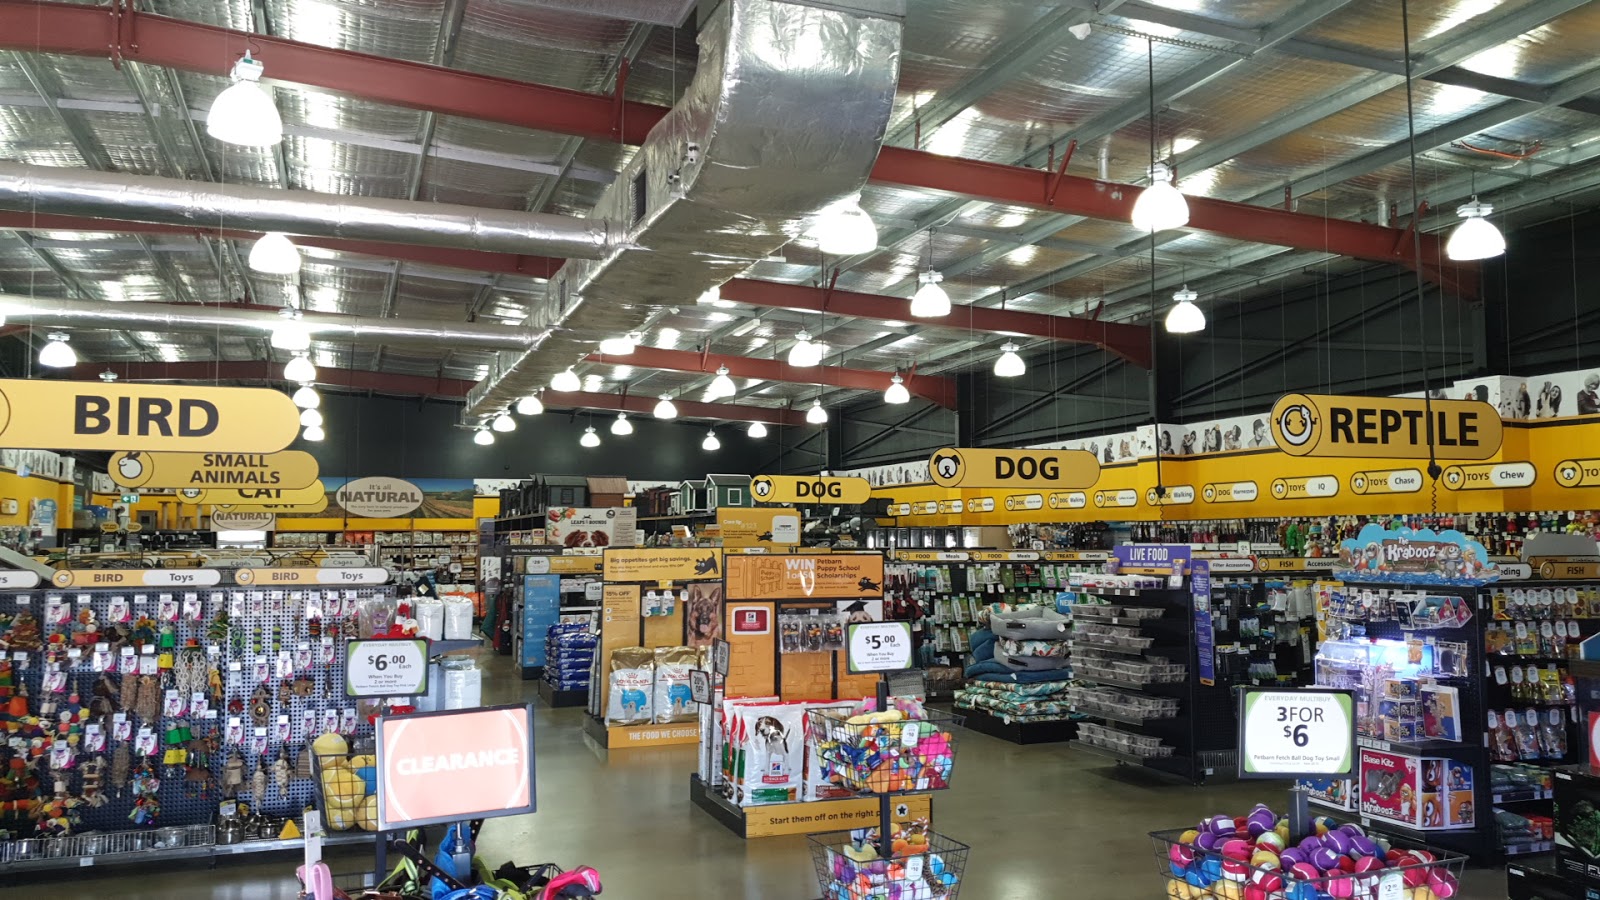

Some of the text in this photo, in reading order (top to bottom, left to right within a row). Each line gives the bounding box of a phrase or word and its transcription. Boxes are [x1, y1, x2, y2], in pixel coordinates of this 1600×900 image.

[74, 395, 219, 437] BIRD
[1330, 407, 1480, 447] REPTILE
[203, 453, 269, 468] SMALL
[995, 456, 1060, 480] DOG
[190, 470, 281, 485] ANIMALS
[1394, 477, 1415, 485] Chase
[1466, 471, 1525, 481] TOYS Chew
[238, 488, 281, 499] CAT
[796, 481, 842, 498] DOG
[1289, 483, 1326, 492] TOYS IQ
[340, 491, 420, 503] NATURAL
[216, 513, 270, 521] NATURAL
[1398, 536, 1409, 545] The
[1129, 548, 1169, 560] LIVE FOOD
[1387, 544, 1436, 561] Krabooz
[785, 558, 815, 570] WIN
[1306, 560, 1336, 568] Accessori
[271, 572, 364, 581] BIRD Toys
[786, 571, 790, 579] 1
[1566, 567, 1584, 575] FISH
[93, 573, 194, 583] BIRD Toys
[865, 634, 896, 649] $5.00
[367, 654, 406, 671] $6.00
[629, 729, 697, 740] THE FOOD WE CHOOSE
[1283, 724, 1309, 748] $6
[396, 747, 519, 776] CLEARANCE
[1302, 754, 1314, 762] Dog
[1363, 754, 1395, 768] Base Kitz
[1363, 801, 1395, 815] Krabooz
[769, 816, 790, 825] Start
[791, 816, 813, 824] them
[814, 813, 826, 821] off
[839, 811, 853, 819] the
[855, 810, 874, 819] right
